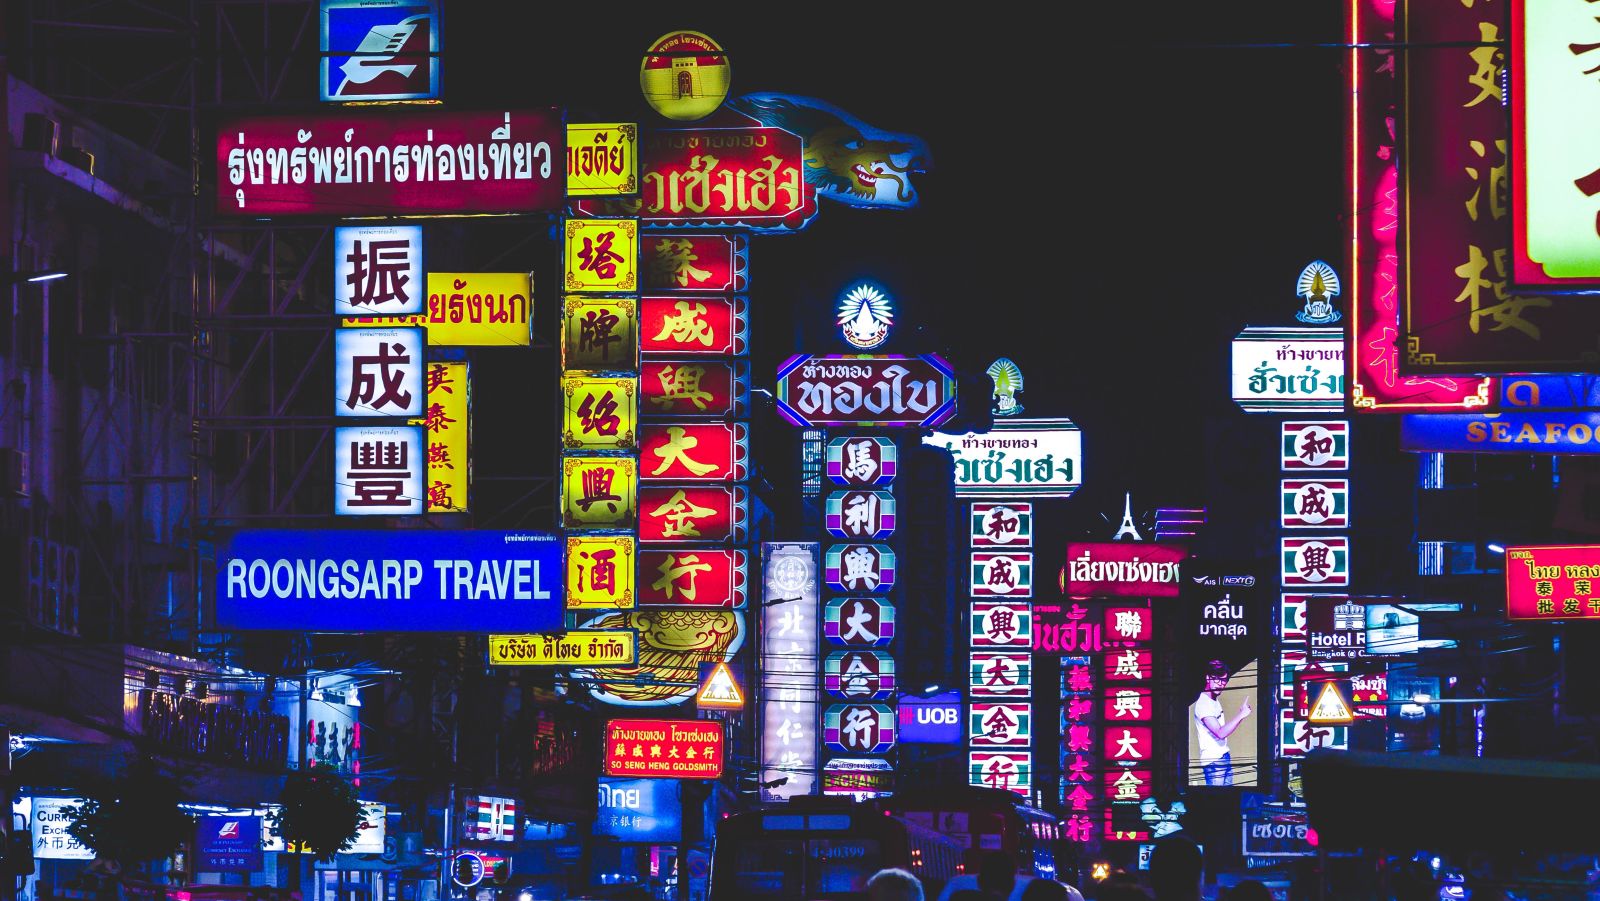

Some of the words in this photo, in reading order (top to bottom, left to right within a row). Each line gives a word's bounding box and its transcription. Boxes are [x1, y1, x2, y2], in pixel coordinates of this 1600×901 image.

[228, 112, 552, 208] รุ่งทรัพย์การท่องเที่ยว
[346, 239, 412, 507] 振成豐
[802, 359, 872, 379] ห้างทอง
[961, 434, 1038, 449] ห้างขายทอง
[227, 558, 423, 599] ROONGSARP
[433, 559, 550, 599] TRAVEL
[1525, 560, 1560, 579] ไทย
[1204, 594, 1244, 619] คลื่น
[1199, 624, 1248, 640] มากสุด
[1311, 632, 1352, 646] Hotel
[499, 639, 537, 659] บริษัท
[588, 637, 624, 658] จำกัด
[917, 707, 958, 725] UOB
[1113, 611, 1145, 839] 聯成興大金
[612, 726, 666, 741] ห้างขายทอง
[611, 761, 622, 769] SO
[625, 761, 646, 770] SENG
[648, 762, 670, 770] HENG
[673, 762, 718, 772] GOLDSMITH
[824, 774, 887, 788] EXCHAN
